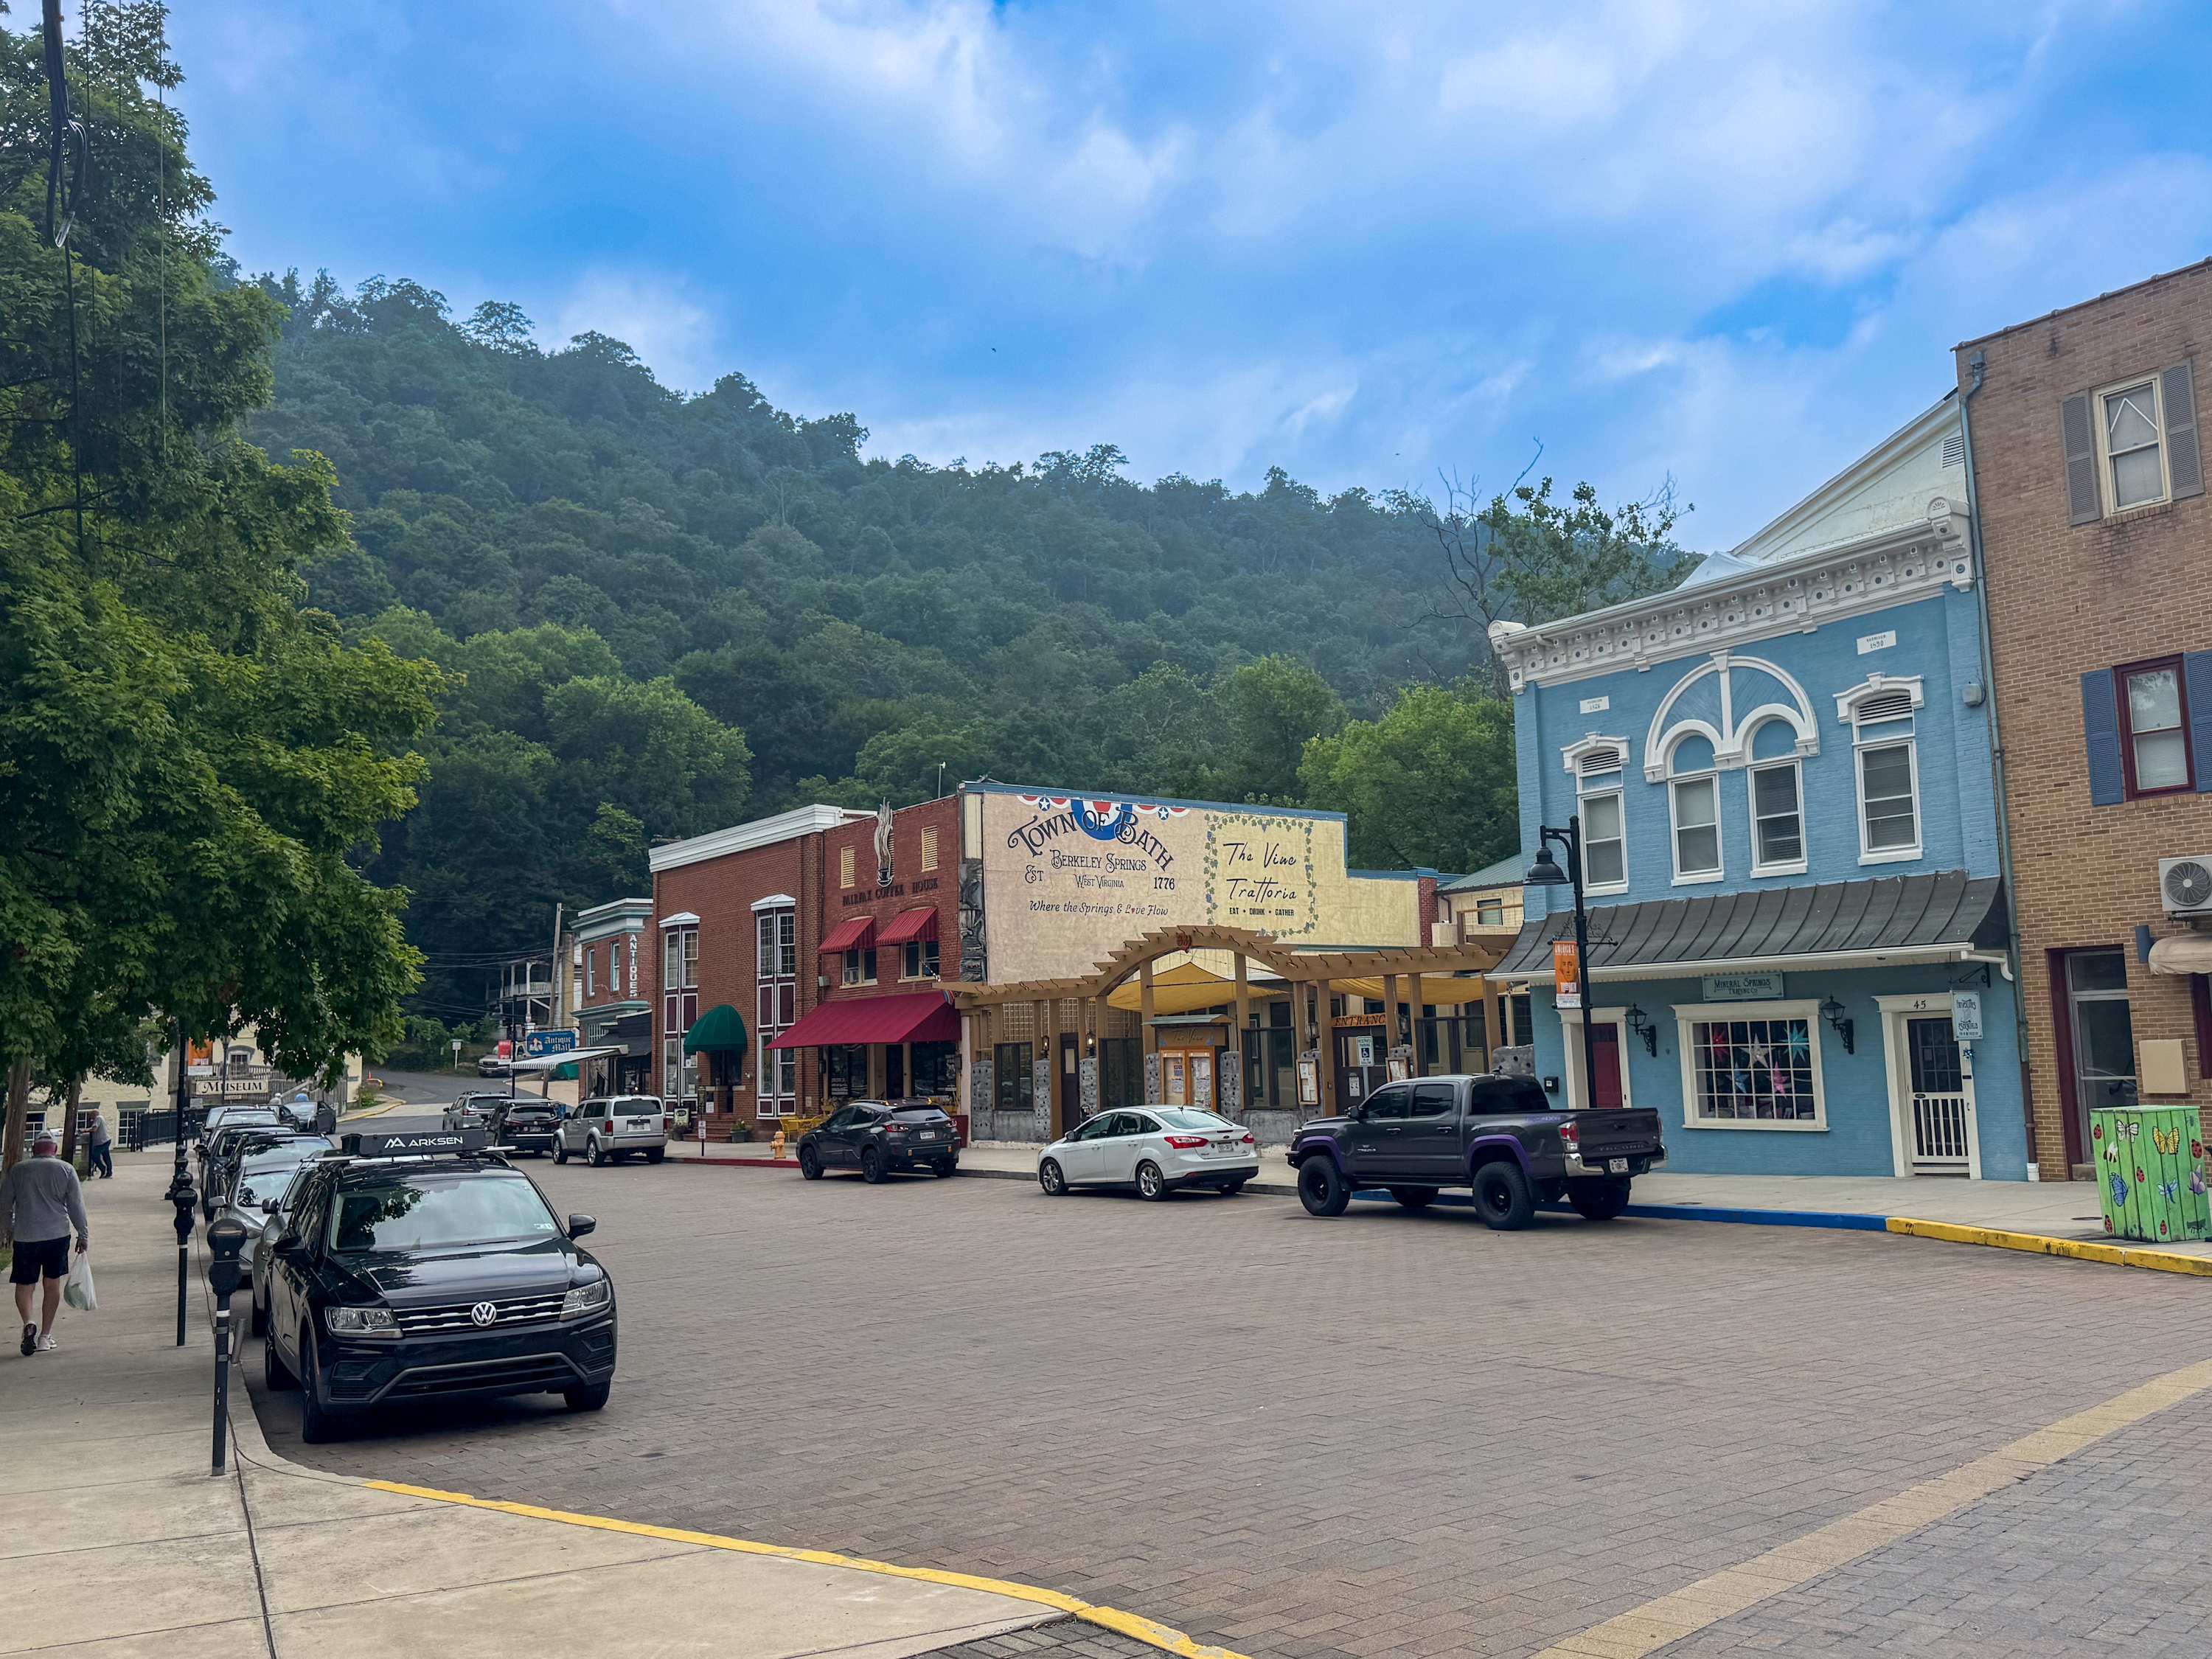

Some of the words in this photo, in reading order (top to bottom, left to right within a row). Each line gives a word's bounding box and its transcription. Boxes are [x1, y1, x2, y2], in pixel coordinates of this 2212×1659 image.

[1008, 812, 1077, 858] TOWN
[1082, 810, 1110, 832] OF
[1114, 807, 1175, 872] BATH
[1050, 849, 1102, 869] BERKELEY
[1105, 853, 1147, 873] SPRINGS
[1222, 841, 1253, 866] The
[1263, 842, 1296, 869] Vine
[875, 884, 904, 899] COFFEE
[912, 878, 938, 894] HOUSE
[1074, 874, 1095, 888] WEST
[1095, 876, 1124, 889] VIRGINIA
[1153, 877, 1175, 890] 1776
[1226, 877, 1297, 903] Trattoria
[1029, 900, 1060, 912] Where
[1063, 901, 1078, 913] the
[1079, 902, 1114, 917] Springs
[1116, 903, 1122, 914] &
[1147, 904, 1169, 916] Flow
[1229, 907, 1239, 915] EAT
[1249, 908, 1265, 916] DRINK
[1275, 908, 1294, 917] GATHER
[630, 934, 638, 997] ANTIQUES
[1714, 978, 1740, 992] MINERAL
[1743, 978, 1770, 987] SPRINGS
[1913, 999, 1926, 1009] 45
[1335, 1015, 1385, 1026] ENTRANC
[552, 1043, 571, 1052] Mall
[408, 1136, 463, 1147] ARKSEN
